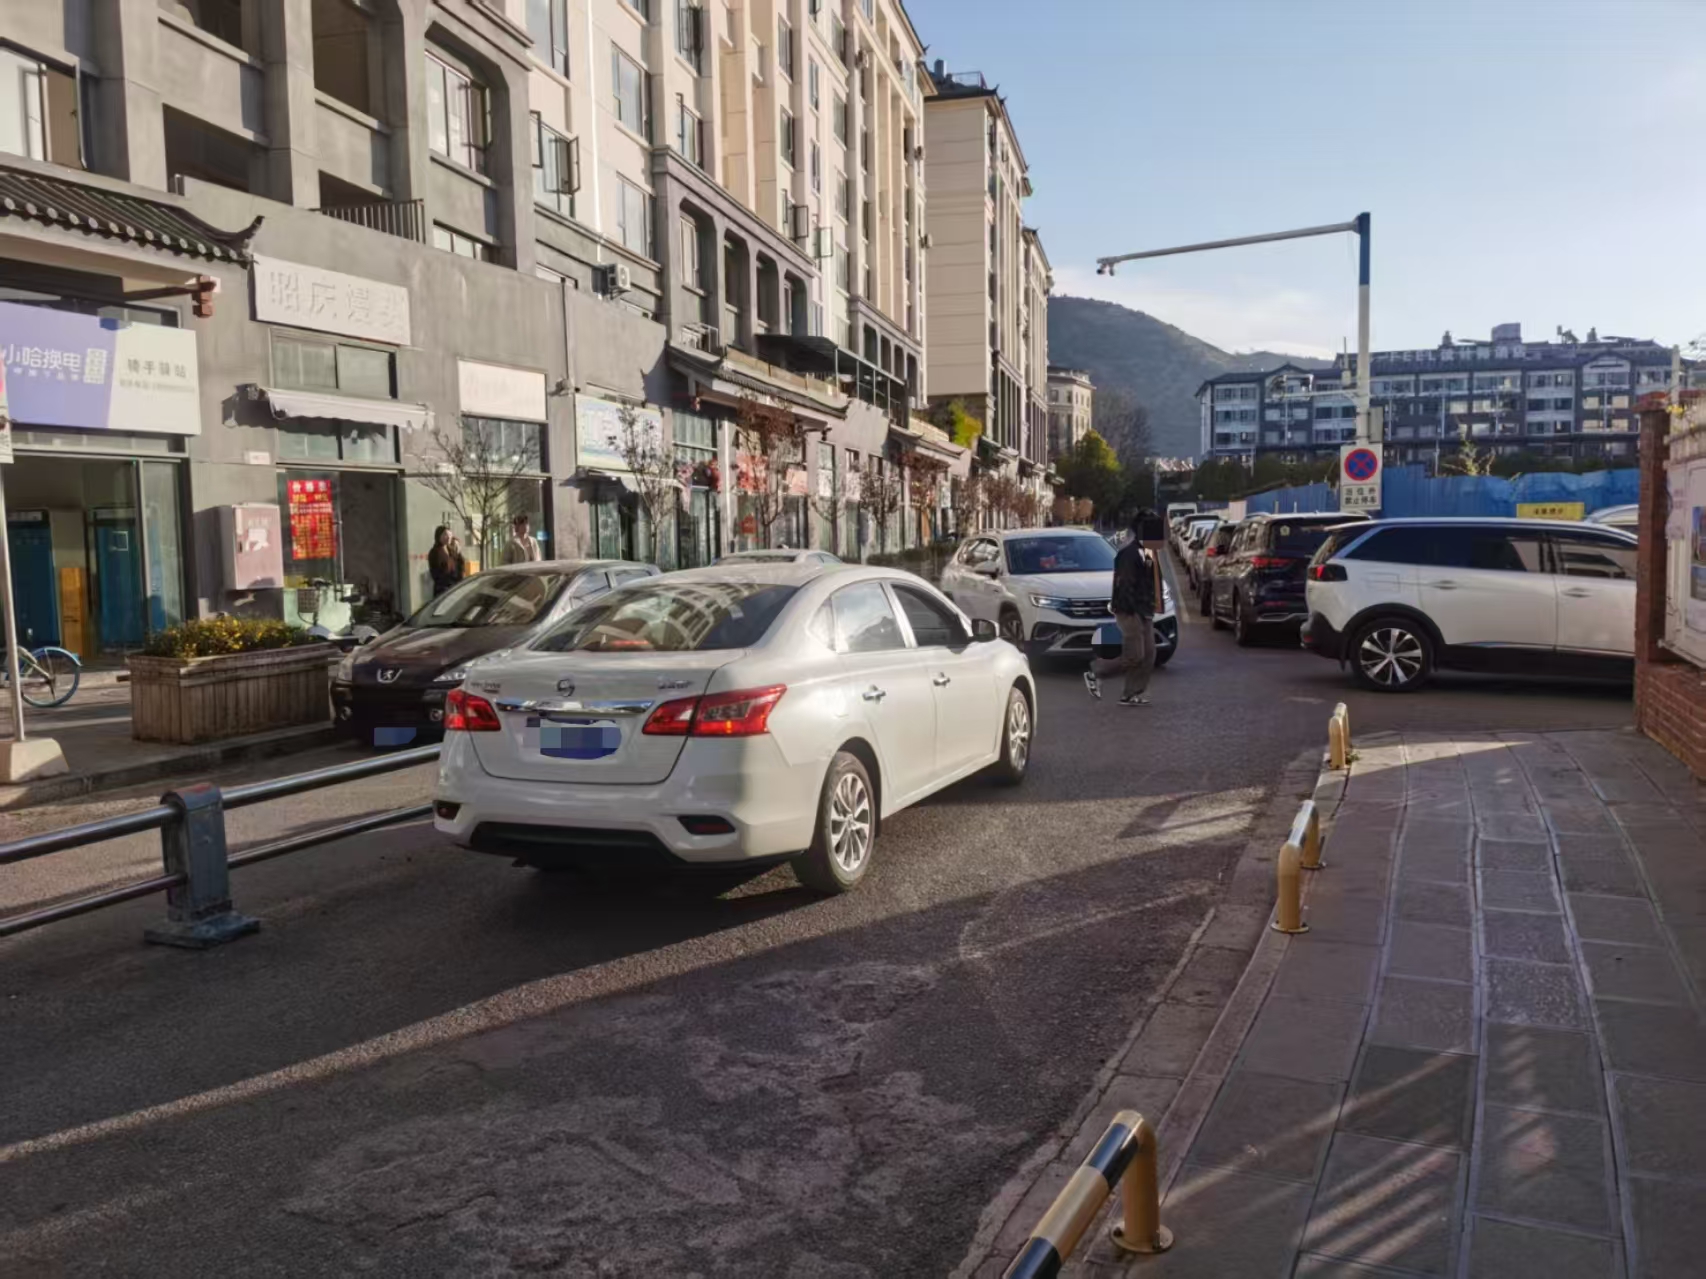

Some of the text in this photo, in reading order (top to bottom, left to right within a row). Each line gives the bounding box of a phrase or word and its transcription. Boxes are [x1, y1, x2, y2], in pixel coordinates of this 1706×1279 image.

[3, 343, 81, 373] 小哈换电
[128, 358, 187, 379] 骑手驿站
[1345, 495, 1377, 505] 禁止停车
